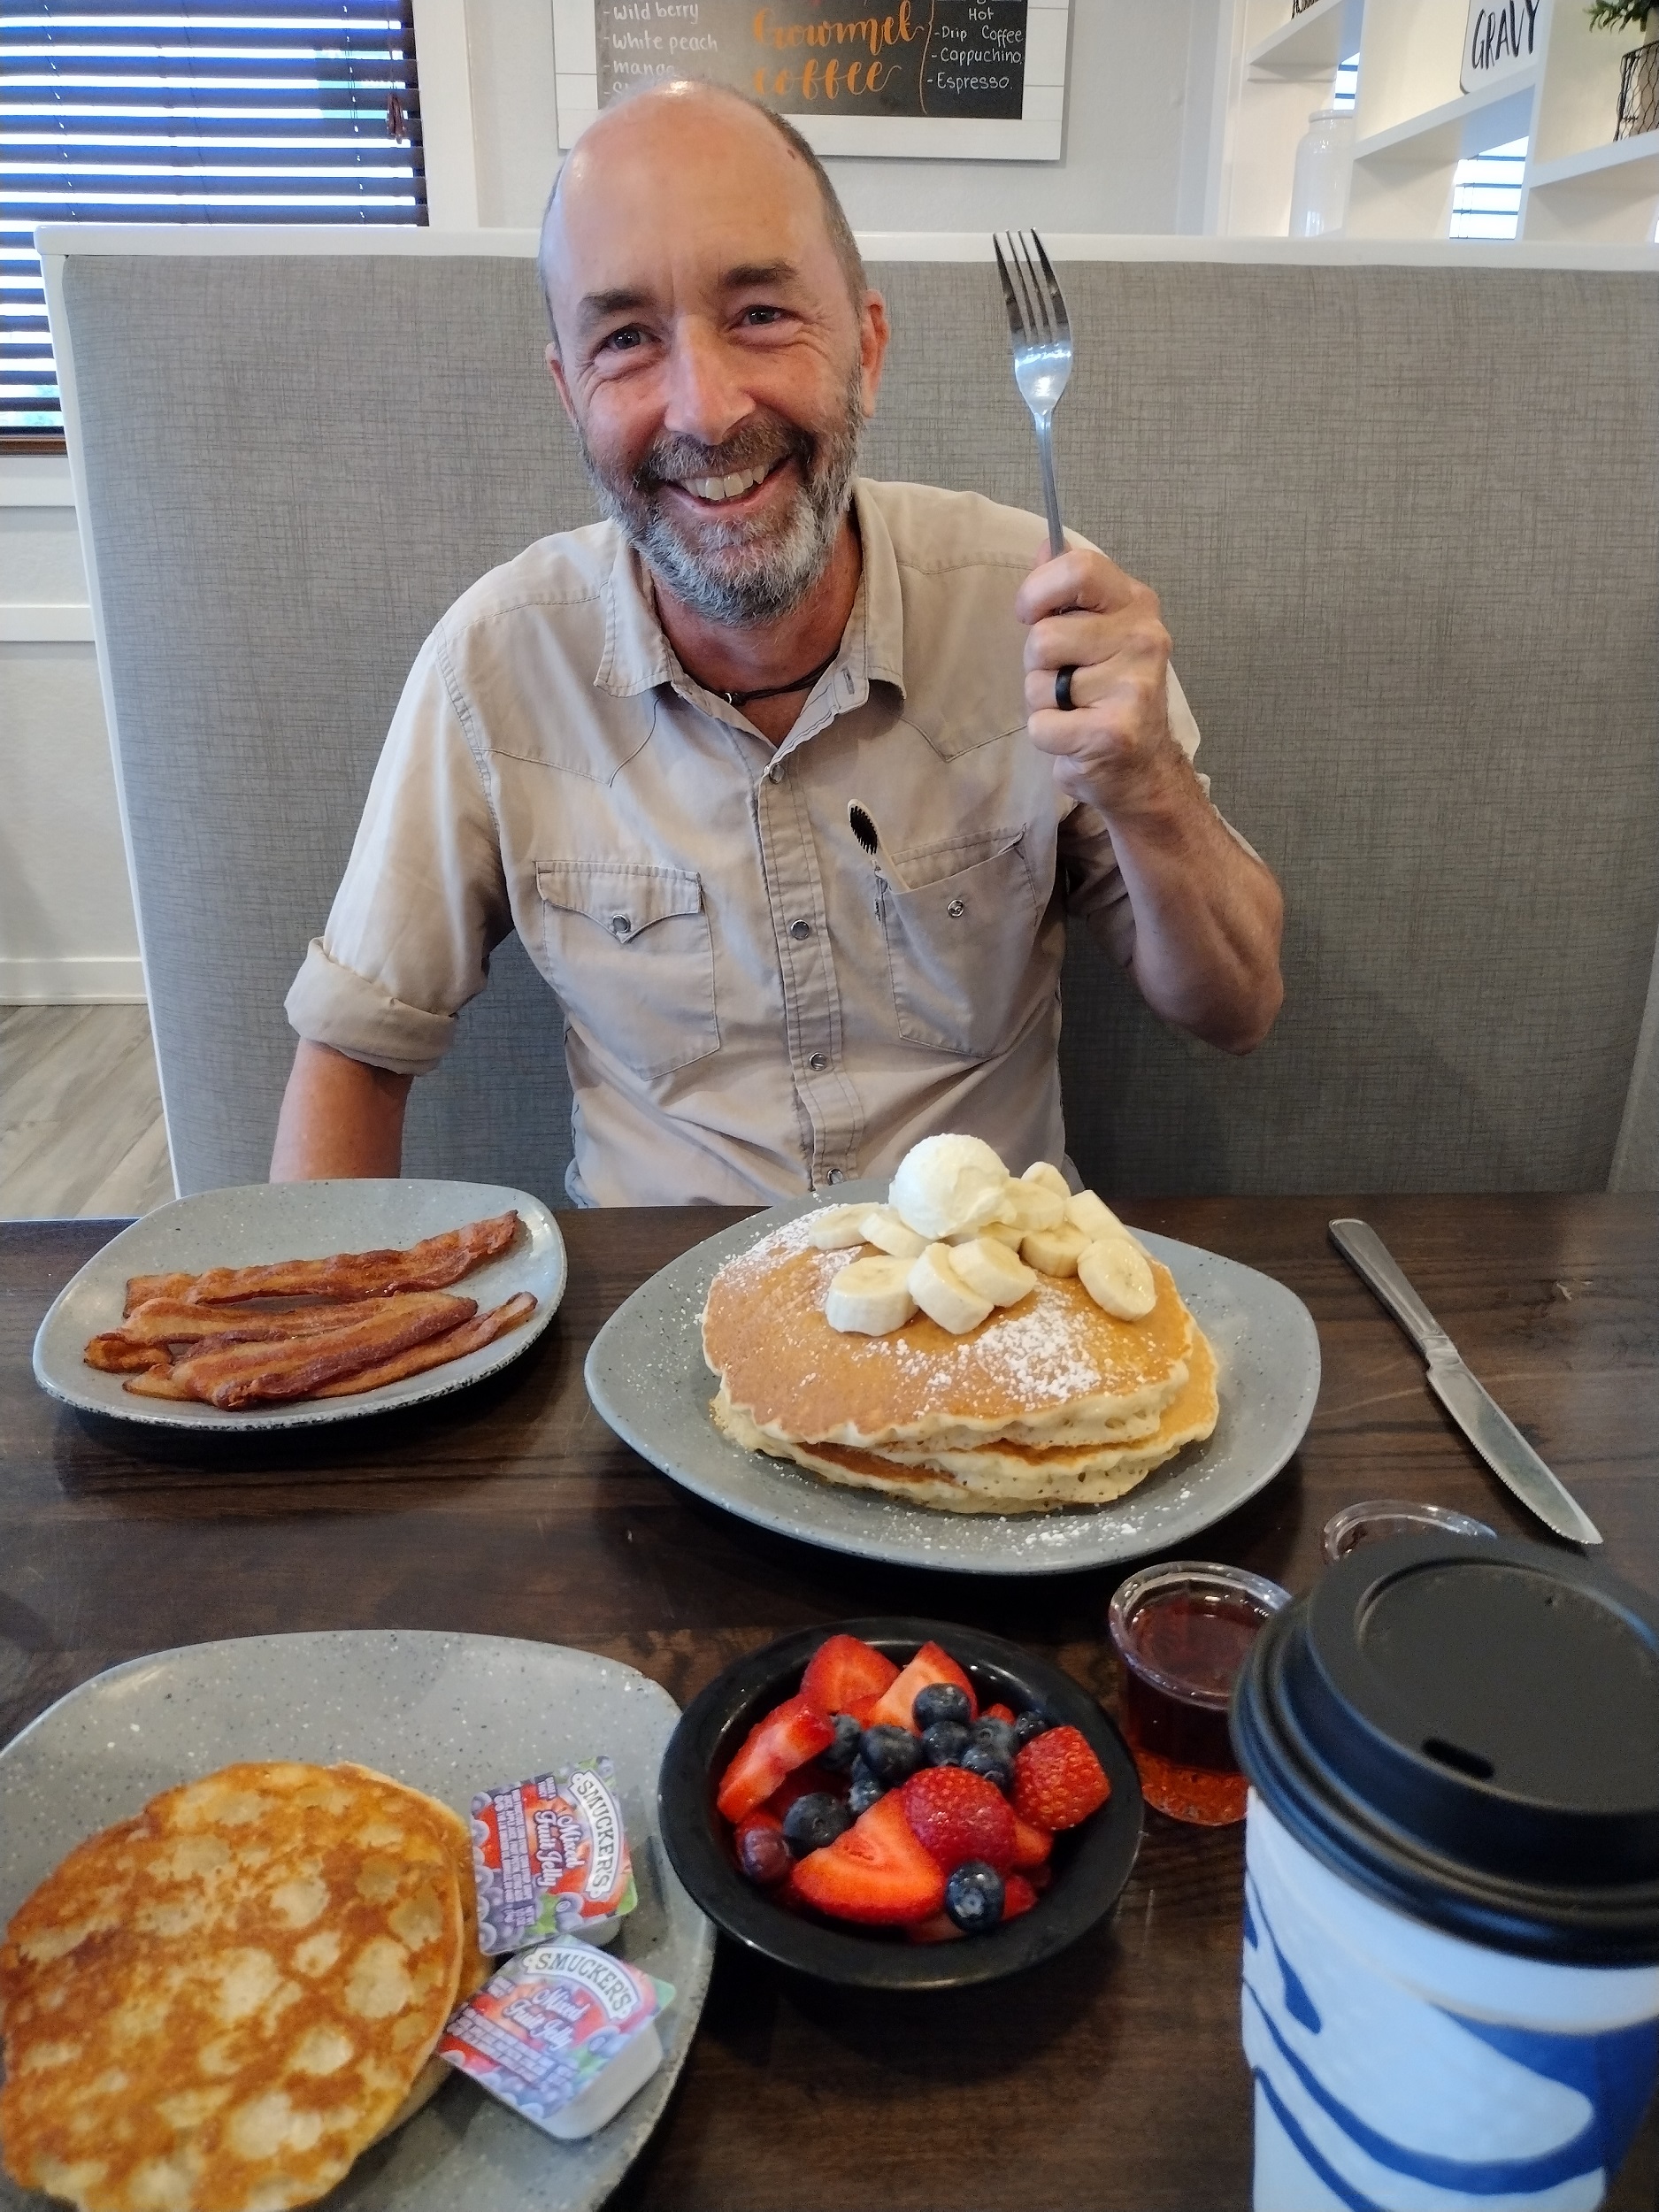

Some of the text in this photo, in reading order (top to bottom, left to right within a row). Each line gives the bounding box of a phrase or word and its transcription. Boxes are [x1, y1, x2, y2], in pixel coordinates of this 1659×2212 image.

[656, 2, 698, 25] berry
[968, 6, 994, 21] Hot
[981, 25, 1024, 49] Coffee
[1471, 0, 1540, 70] GRAVY
[669, 34, 718, 55] peach
[535, 1811, 563, 1887] Fruit Jelly
[557, 1816, 585, 1869] Mixed
[577, 1778, 616, 1893] SMUCKER'S
[532, 1987, 591, 2022] Mixed
[535, 1953, 632, 2016] SMUCKER'S
[503, 2000, 546, 2030] Fruit
[530, 2019, 574, 2051] Jelly
